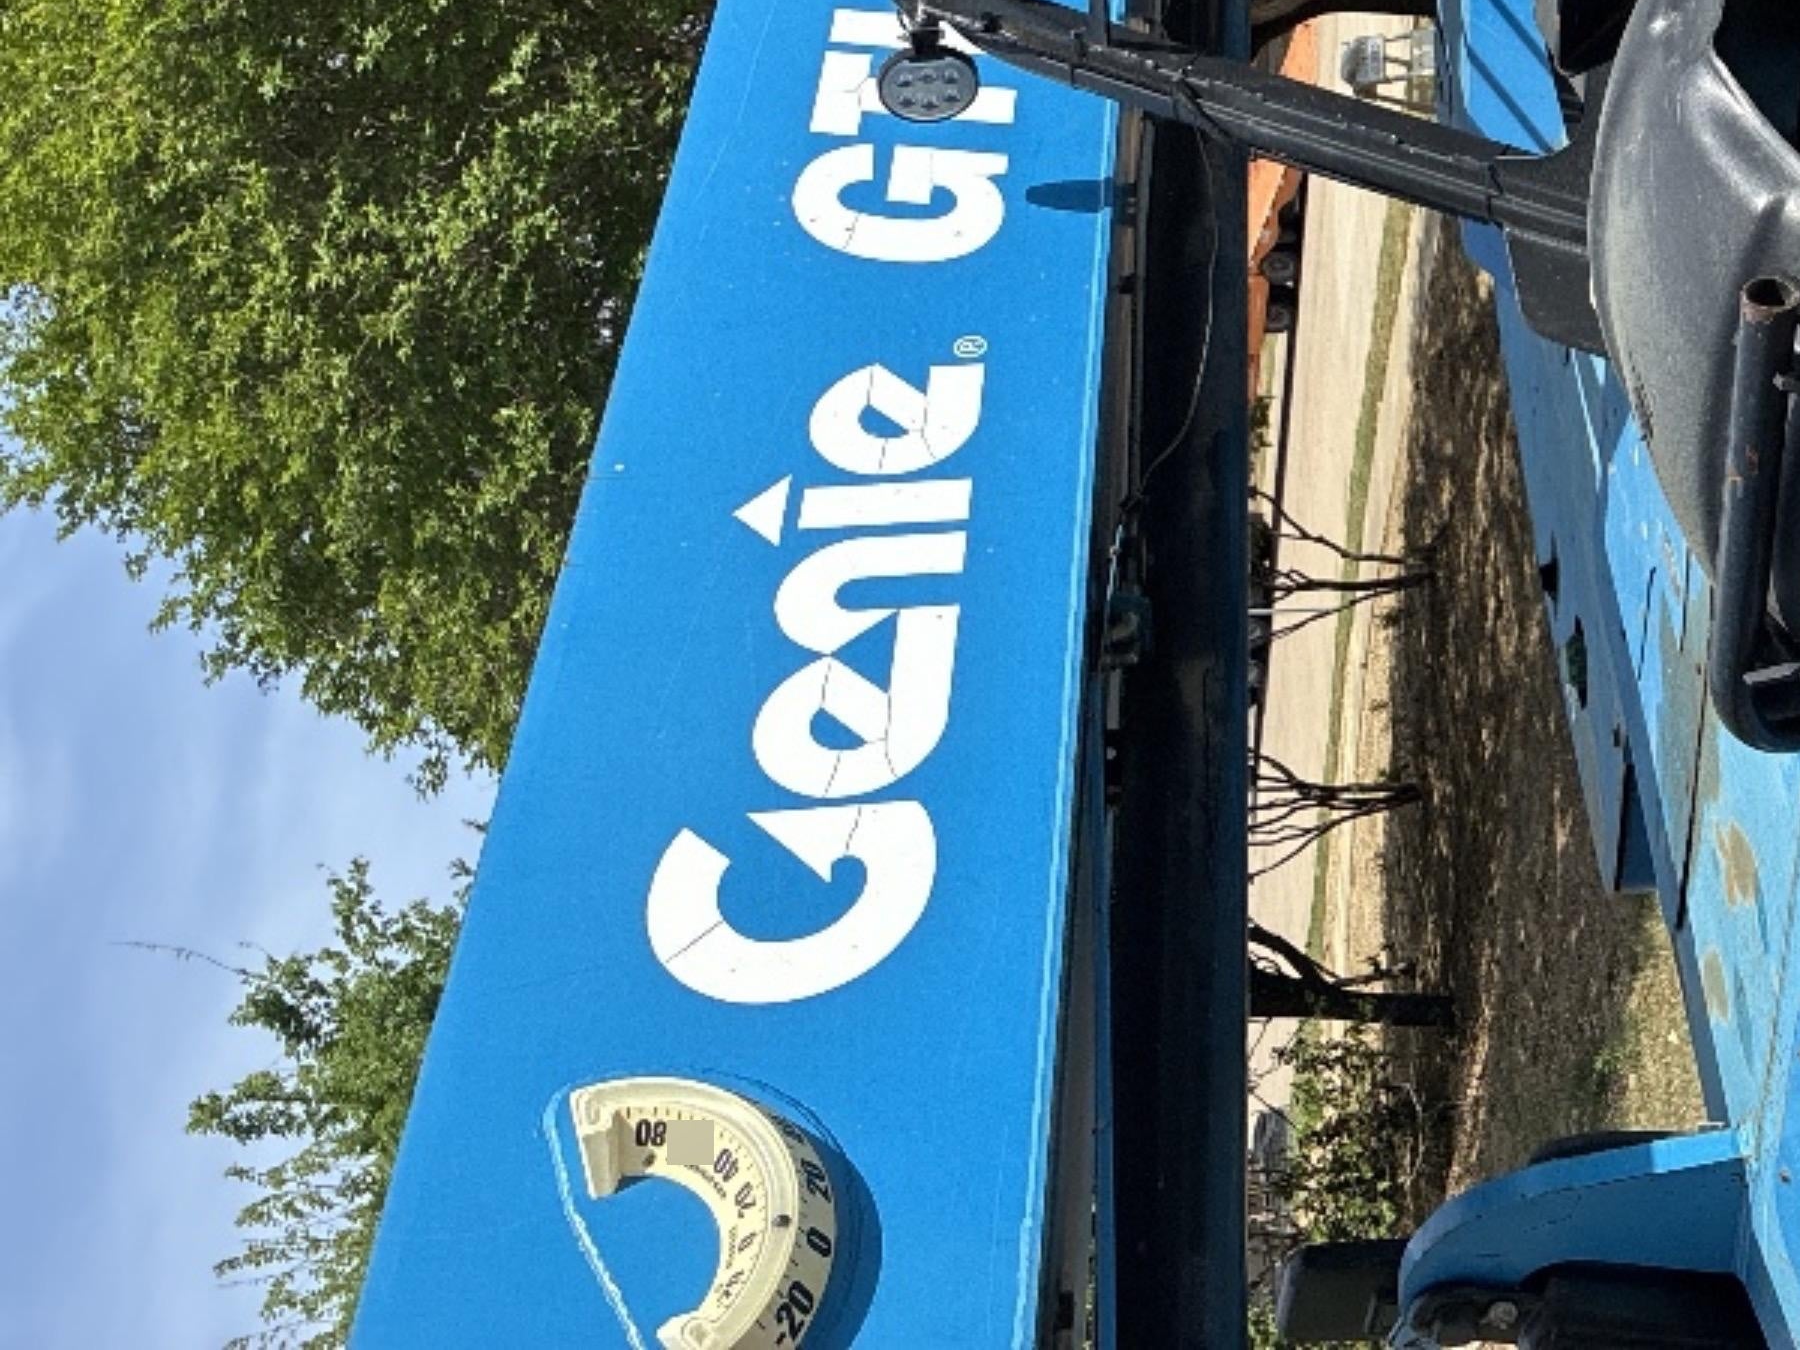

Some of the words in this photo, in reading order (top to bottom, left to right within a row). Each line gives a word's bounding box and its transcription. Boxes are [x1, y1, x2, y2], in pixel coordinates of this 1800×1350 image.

[646, 362, 985, 1005] Genie
[635, 1118, 667, 1147] 80
[800, 1158, 832, 1204] 20
[806, 1227, 832, 1258] 0
[775, 1280, 815, 1346] -20
